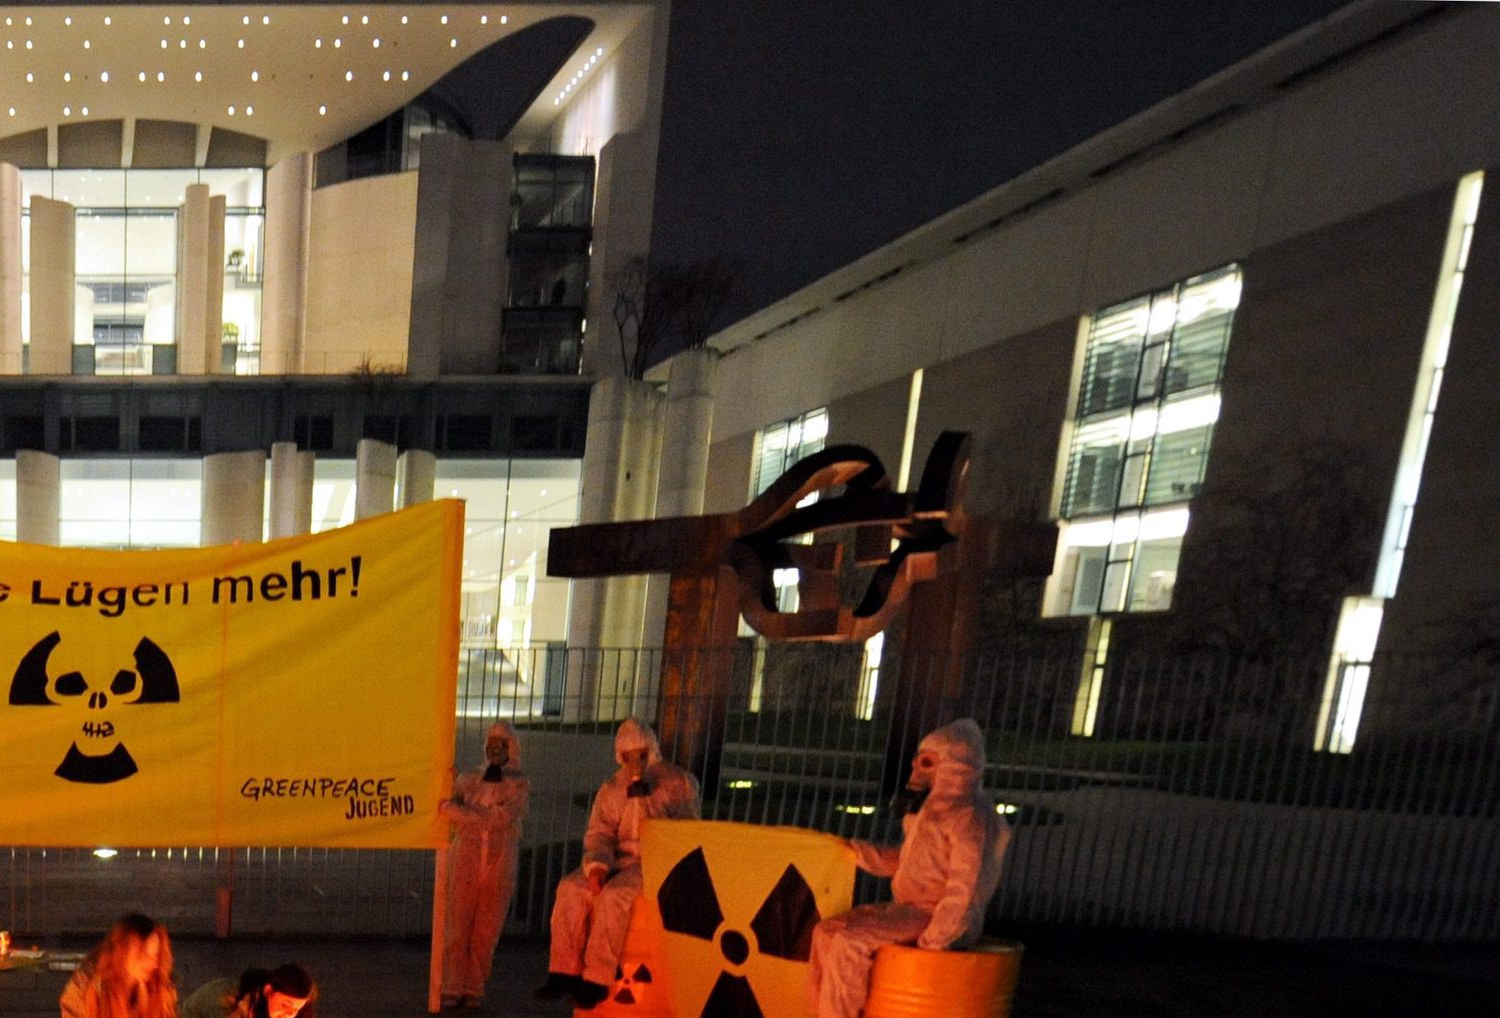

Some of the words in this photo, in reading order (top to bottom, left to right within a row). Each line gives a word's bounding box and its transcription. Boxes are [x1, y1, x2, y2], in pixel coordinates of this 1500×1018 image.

[31, 579, 189, 618] Lügen
[212, 556, 362, 605] mehr!
[240, 777, 395, 802] GREENPEACE
[345, 794, 415, 820] JUGEND
